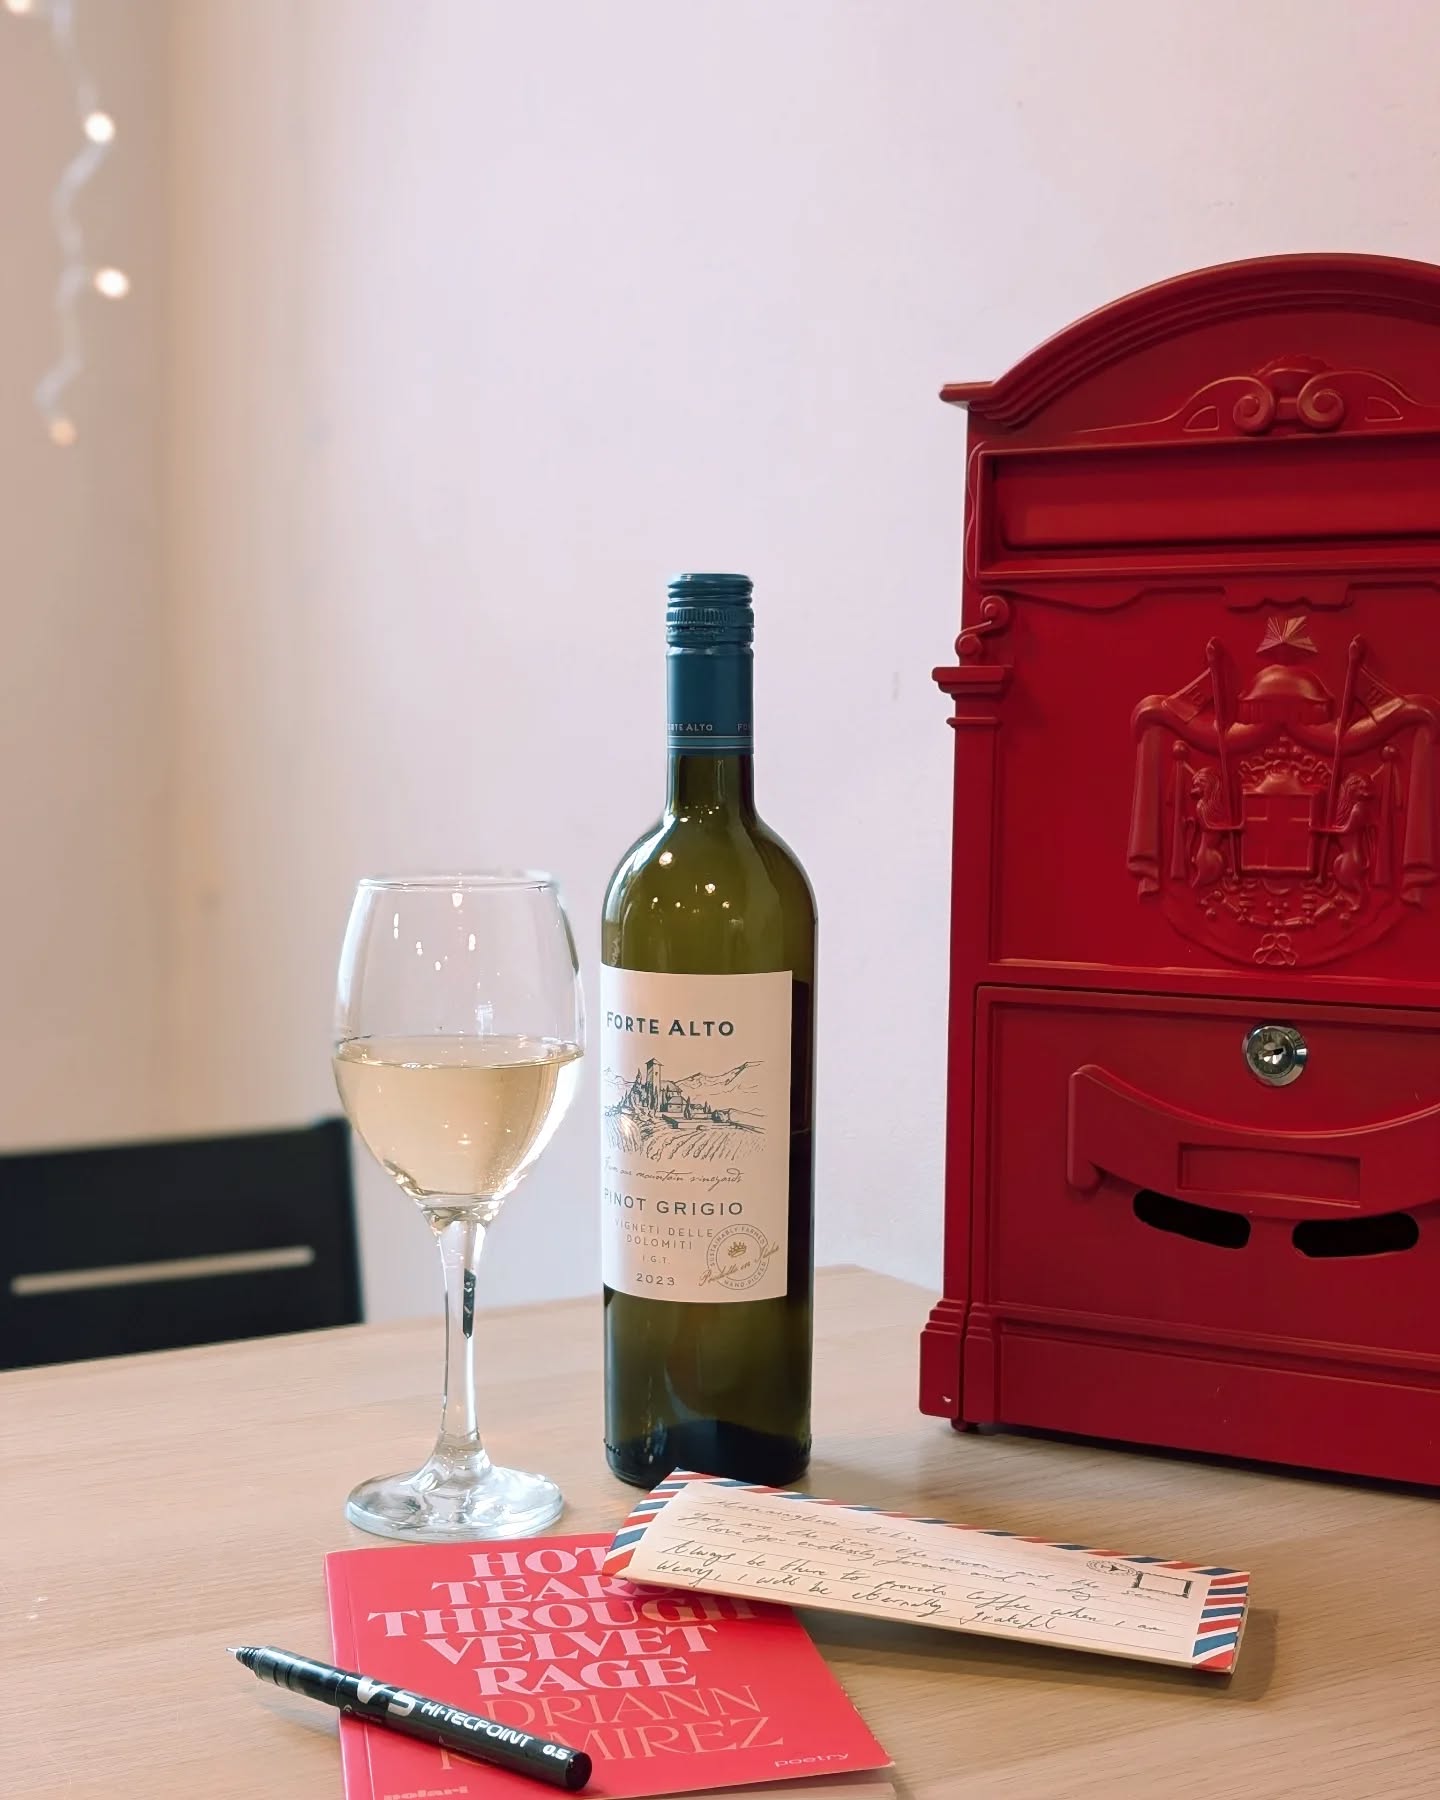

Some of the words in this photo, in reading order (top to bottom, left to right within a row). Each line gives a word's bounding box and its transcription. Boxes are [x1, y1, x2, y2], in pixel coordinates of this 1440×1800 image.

[686, 723, 713, 732] ALTO
[606, 1011, 660, 1035] FORTE
[668, 1019, 734, 1037] ALTO
[689, 1167, 745, 1192] vineyards
[604, 1188, 647, 1211] PINOT
[656, 1200, 743, 1216] GRIGIO
[615, 1218, 660, 1235] VIGNETI
[668, 1227, 713, 1238] DELLE
[626, 1234, 692, 1250] DOLOMITI
[636, 1273, 675, 1286] 2023
[468, 1546, 612, 1577] HOT
[662, 1540, 737, 1567] Always
[746, 1553, 767, 1567] be
[779, 1558, 829, 1577] there
[840, 1569, 870, 1581] to
[1050, 1606, 1098, 1623] when
[1137, 1623, 1166, 1632] am
[756, 1574, 797, 1587] will
[807, 1580, 833, 1596] be
[852, 1588, 950, 1618] eternally
[959, 1611, 1058, 1629] grateful
[367, 1597, 758, 1637] THROUGH
[422, 1624, 718, 1665] VELVET
[472, 1656, 697, 1696] RAGE
[357, 1675, 425, 1717] V5
[542, 1744, 571, 1761] 0.5
[484, 1684, 761, 1729] DRIANN
[440, 1716, 784, 1770] MIREZ
[774, 1752, 850, 1767] poetry
